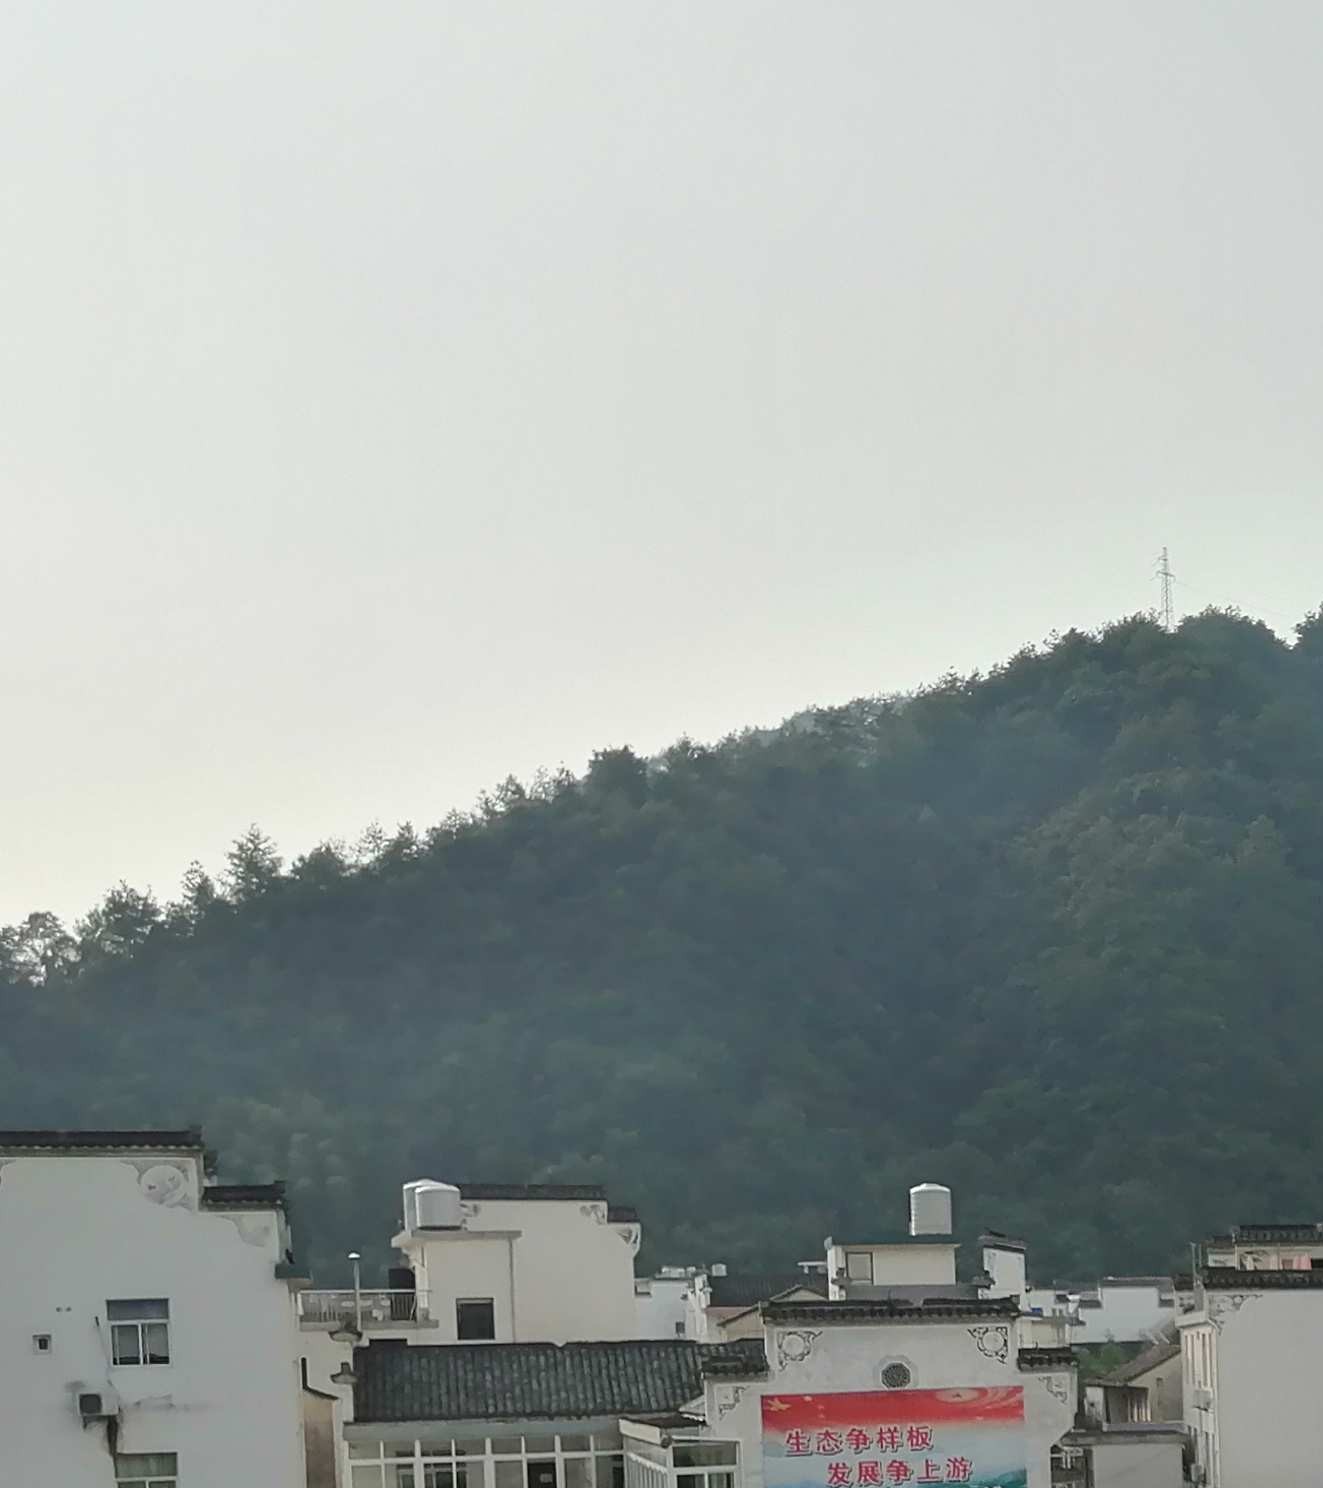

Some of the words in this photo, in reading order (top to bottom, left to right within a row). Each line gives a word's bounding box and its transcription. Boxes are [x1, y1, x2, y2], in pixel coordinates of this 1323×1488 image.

[785, 1426, 935, 1457] 生态争样板
[827, 1457, 974, 1487] 发展争上游
